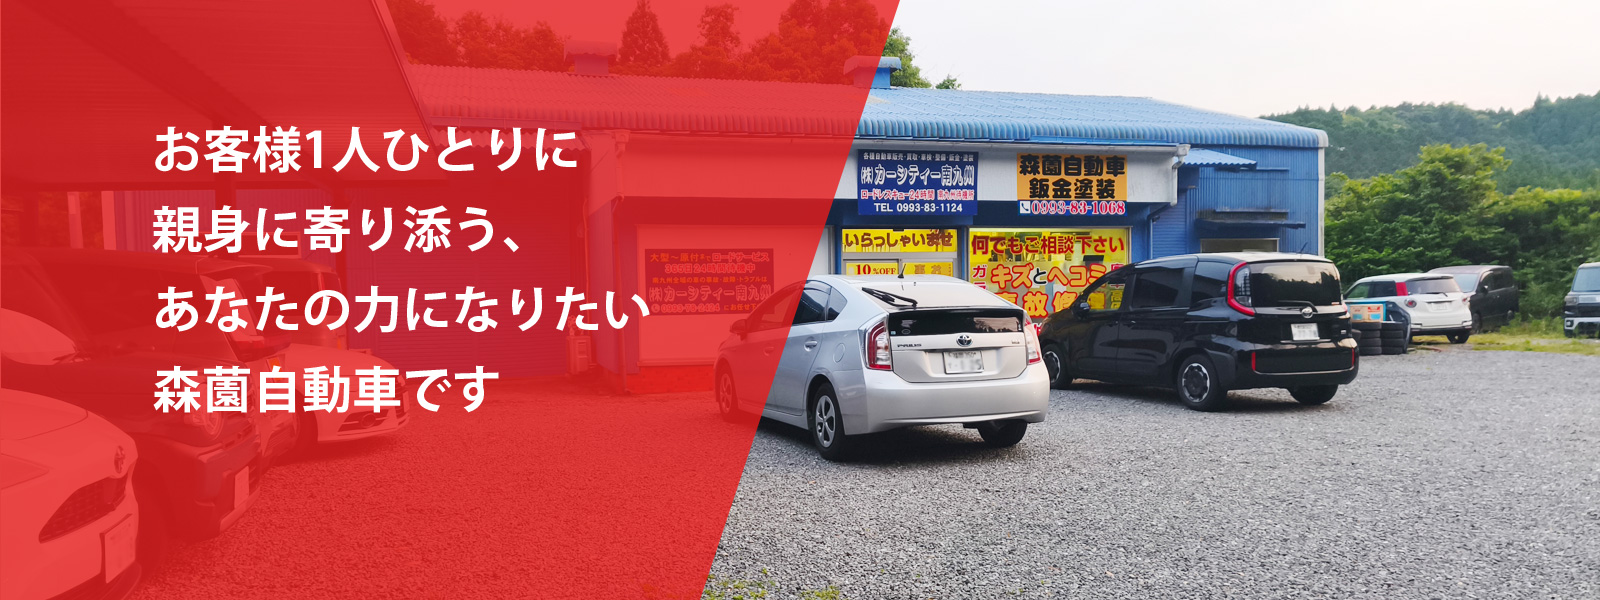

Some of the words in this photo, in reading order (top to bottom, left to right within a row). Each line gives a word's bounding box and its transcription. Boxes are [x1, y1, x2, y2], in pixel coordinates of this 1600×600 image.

[1019, 154, 1126, 177] 森薗自動車
[1029, 178, 1115, 199] 鈑金塗装
[874, 203, 893, 212] TEL
[896, 203, 963, 212] 0993-83-1124
[1031, 200, 1126, 215] 0993-83-1068
[845, 232, 954, 248] いらっしゃいませ
[971, 235, 1125, 255] 何でもご相談下さい
[990, 262, 1107, 289] キズとヘコミ
